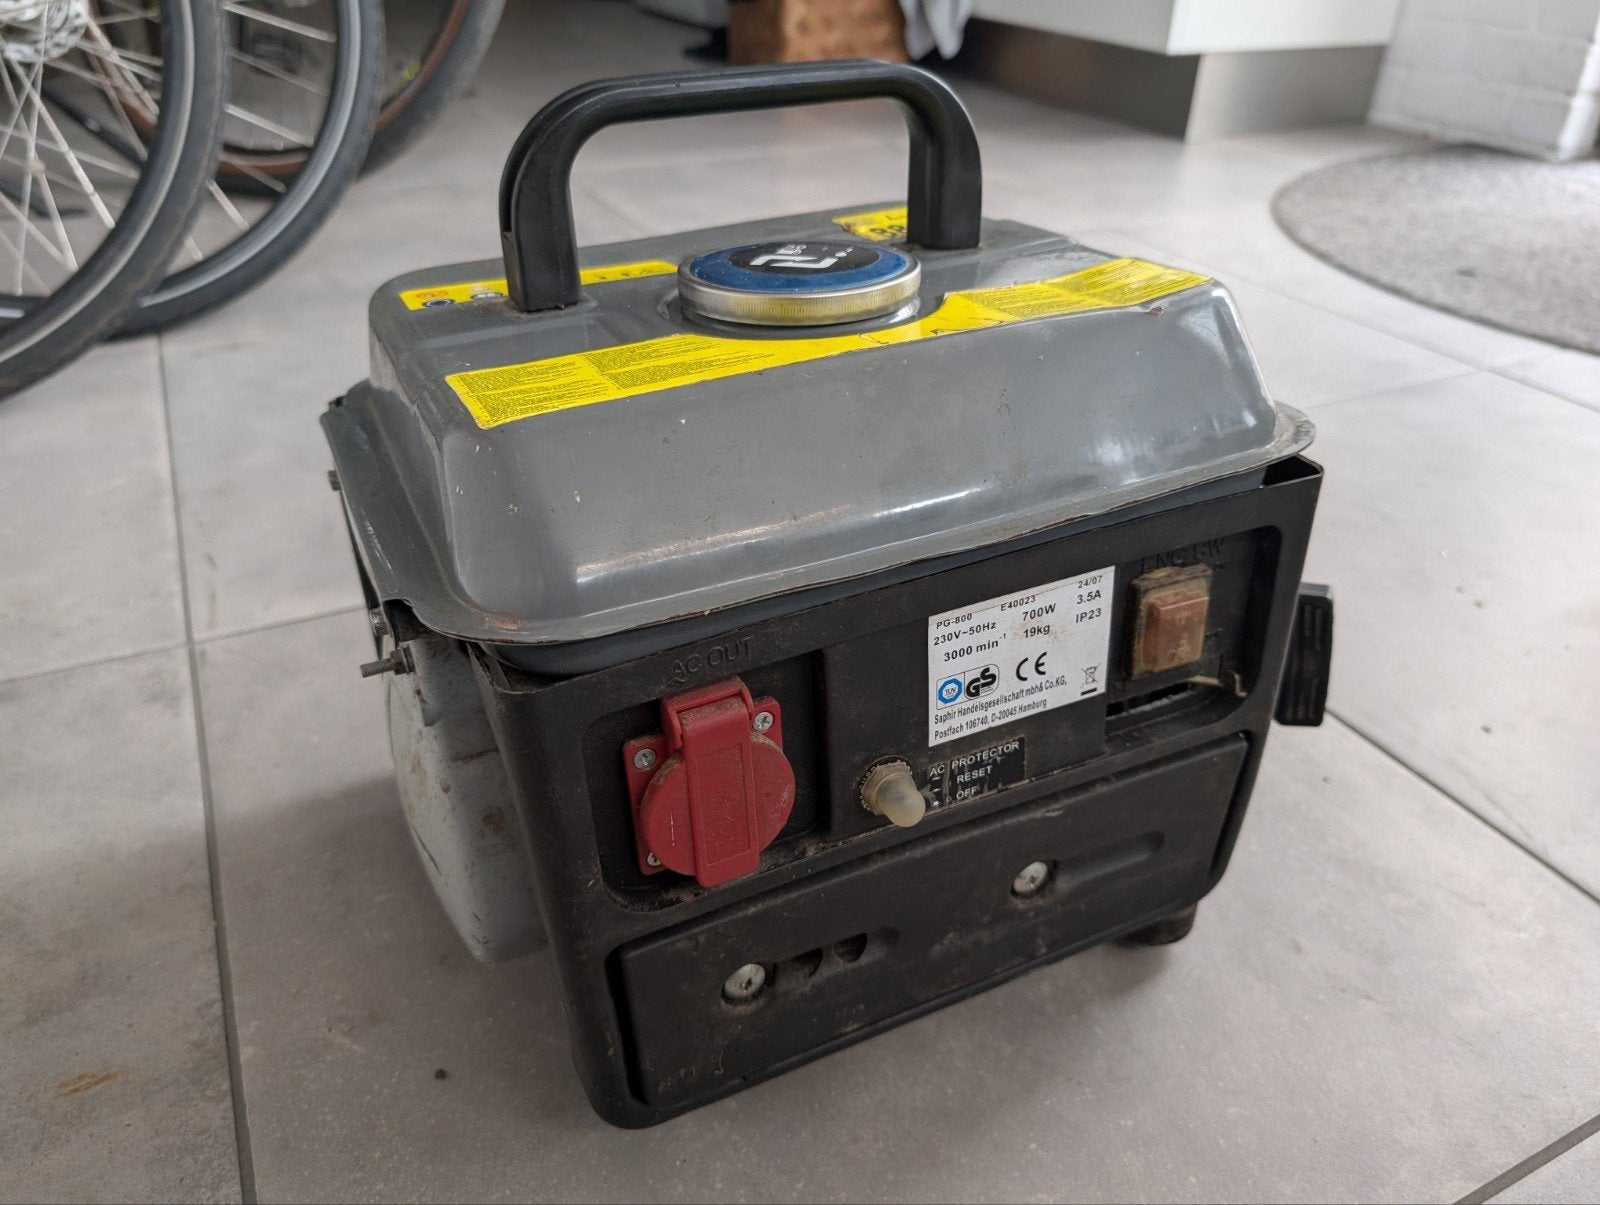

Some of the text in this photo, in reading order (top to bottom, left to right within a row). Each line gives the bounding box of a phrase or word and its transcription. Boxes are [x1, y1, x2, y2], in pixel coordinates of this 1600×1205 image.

[933, 589, 1102, 646] 230V~50Hz 700W 3.5A
[936, 575, 1103, 630] PG-800 E40023 24/07
[944, 646, 973, 662] 3000
[1023, 624, 1051, 640] 19kg
[1075, 607, 1102, 624] IP23
[671, 635, 754, 677] AC OUT
[1016, 651, 1048, 682] CE
[966, 667, 997, 698] GS
[934, 710, 957, 725] Saphir
[957, 689, 1025, 719] Handelsgesellschaft
[934, 699, 1048, 741] Postfach 106740, D-20045 Hamburg
[929, 741, 1020, 777] AC PROTECTOR
[956, 765, 993, 784] RESET
[956, 785, 979, 801] OFF
